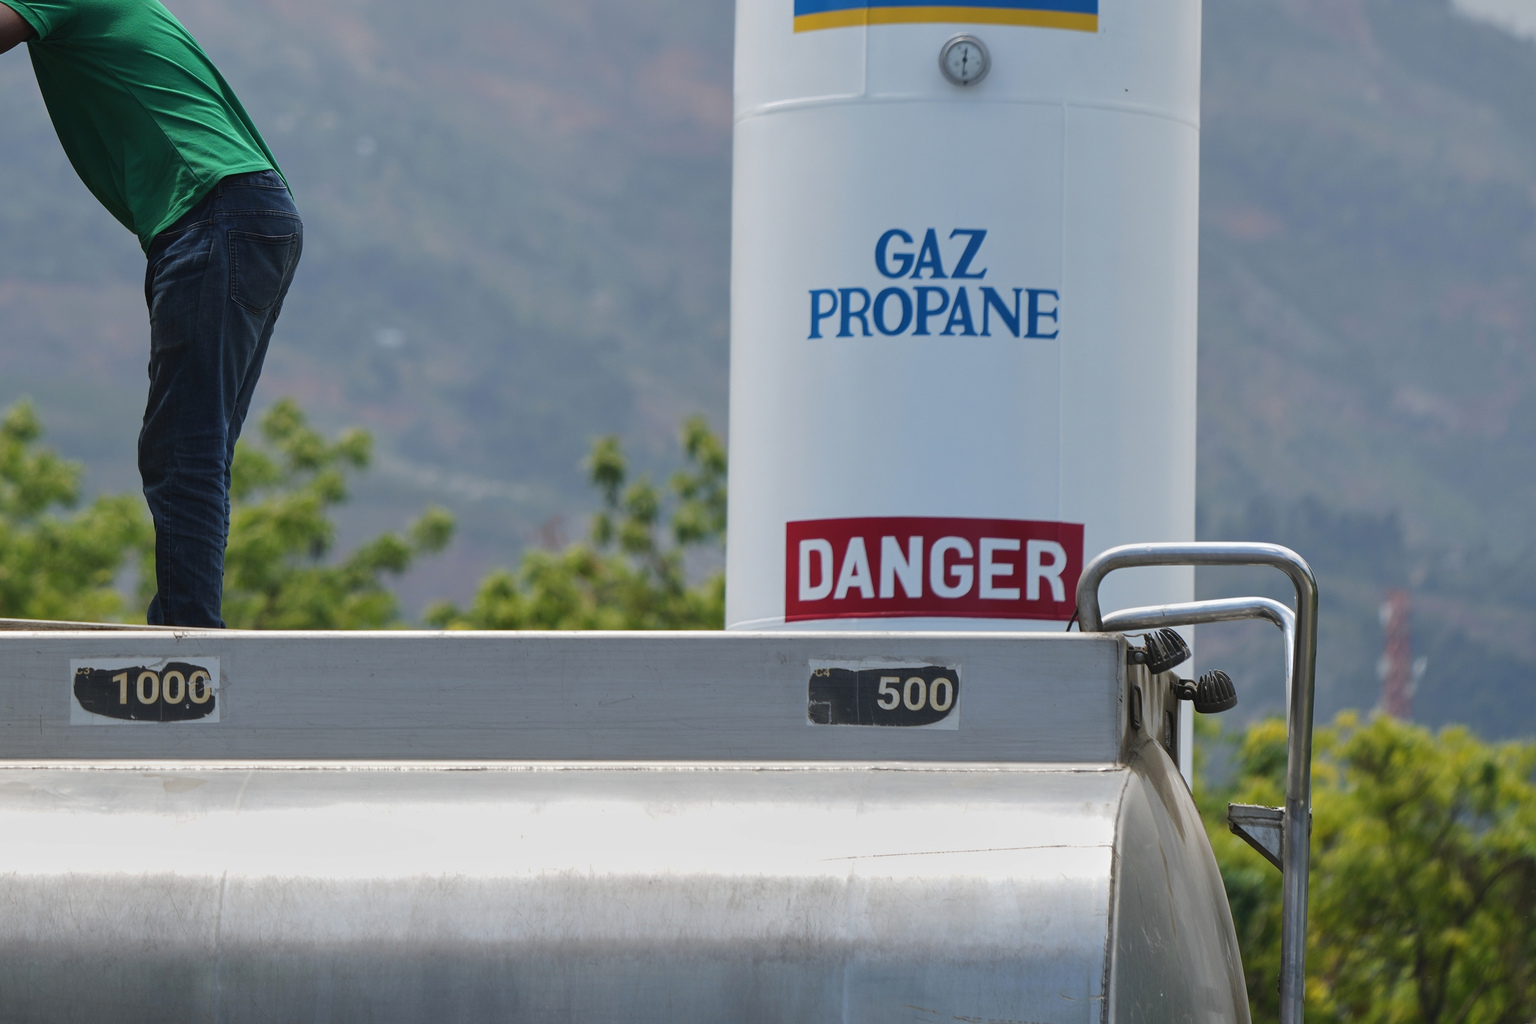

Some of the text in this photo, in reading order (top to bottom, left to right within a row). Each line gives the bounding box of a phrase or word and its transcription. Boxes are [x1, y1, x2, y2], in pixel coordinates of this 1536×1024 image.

[874, 227, 989, 280] GAZ
[806, 286, 1061, 340] PROPANE
[797, 535, 1068, 602] DANGER
[112, 670, 212, 705] 1000
[814, 668, 831, 677] C4
[876, 676, 953, 712] 500
